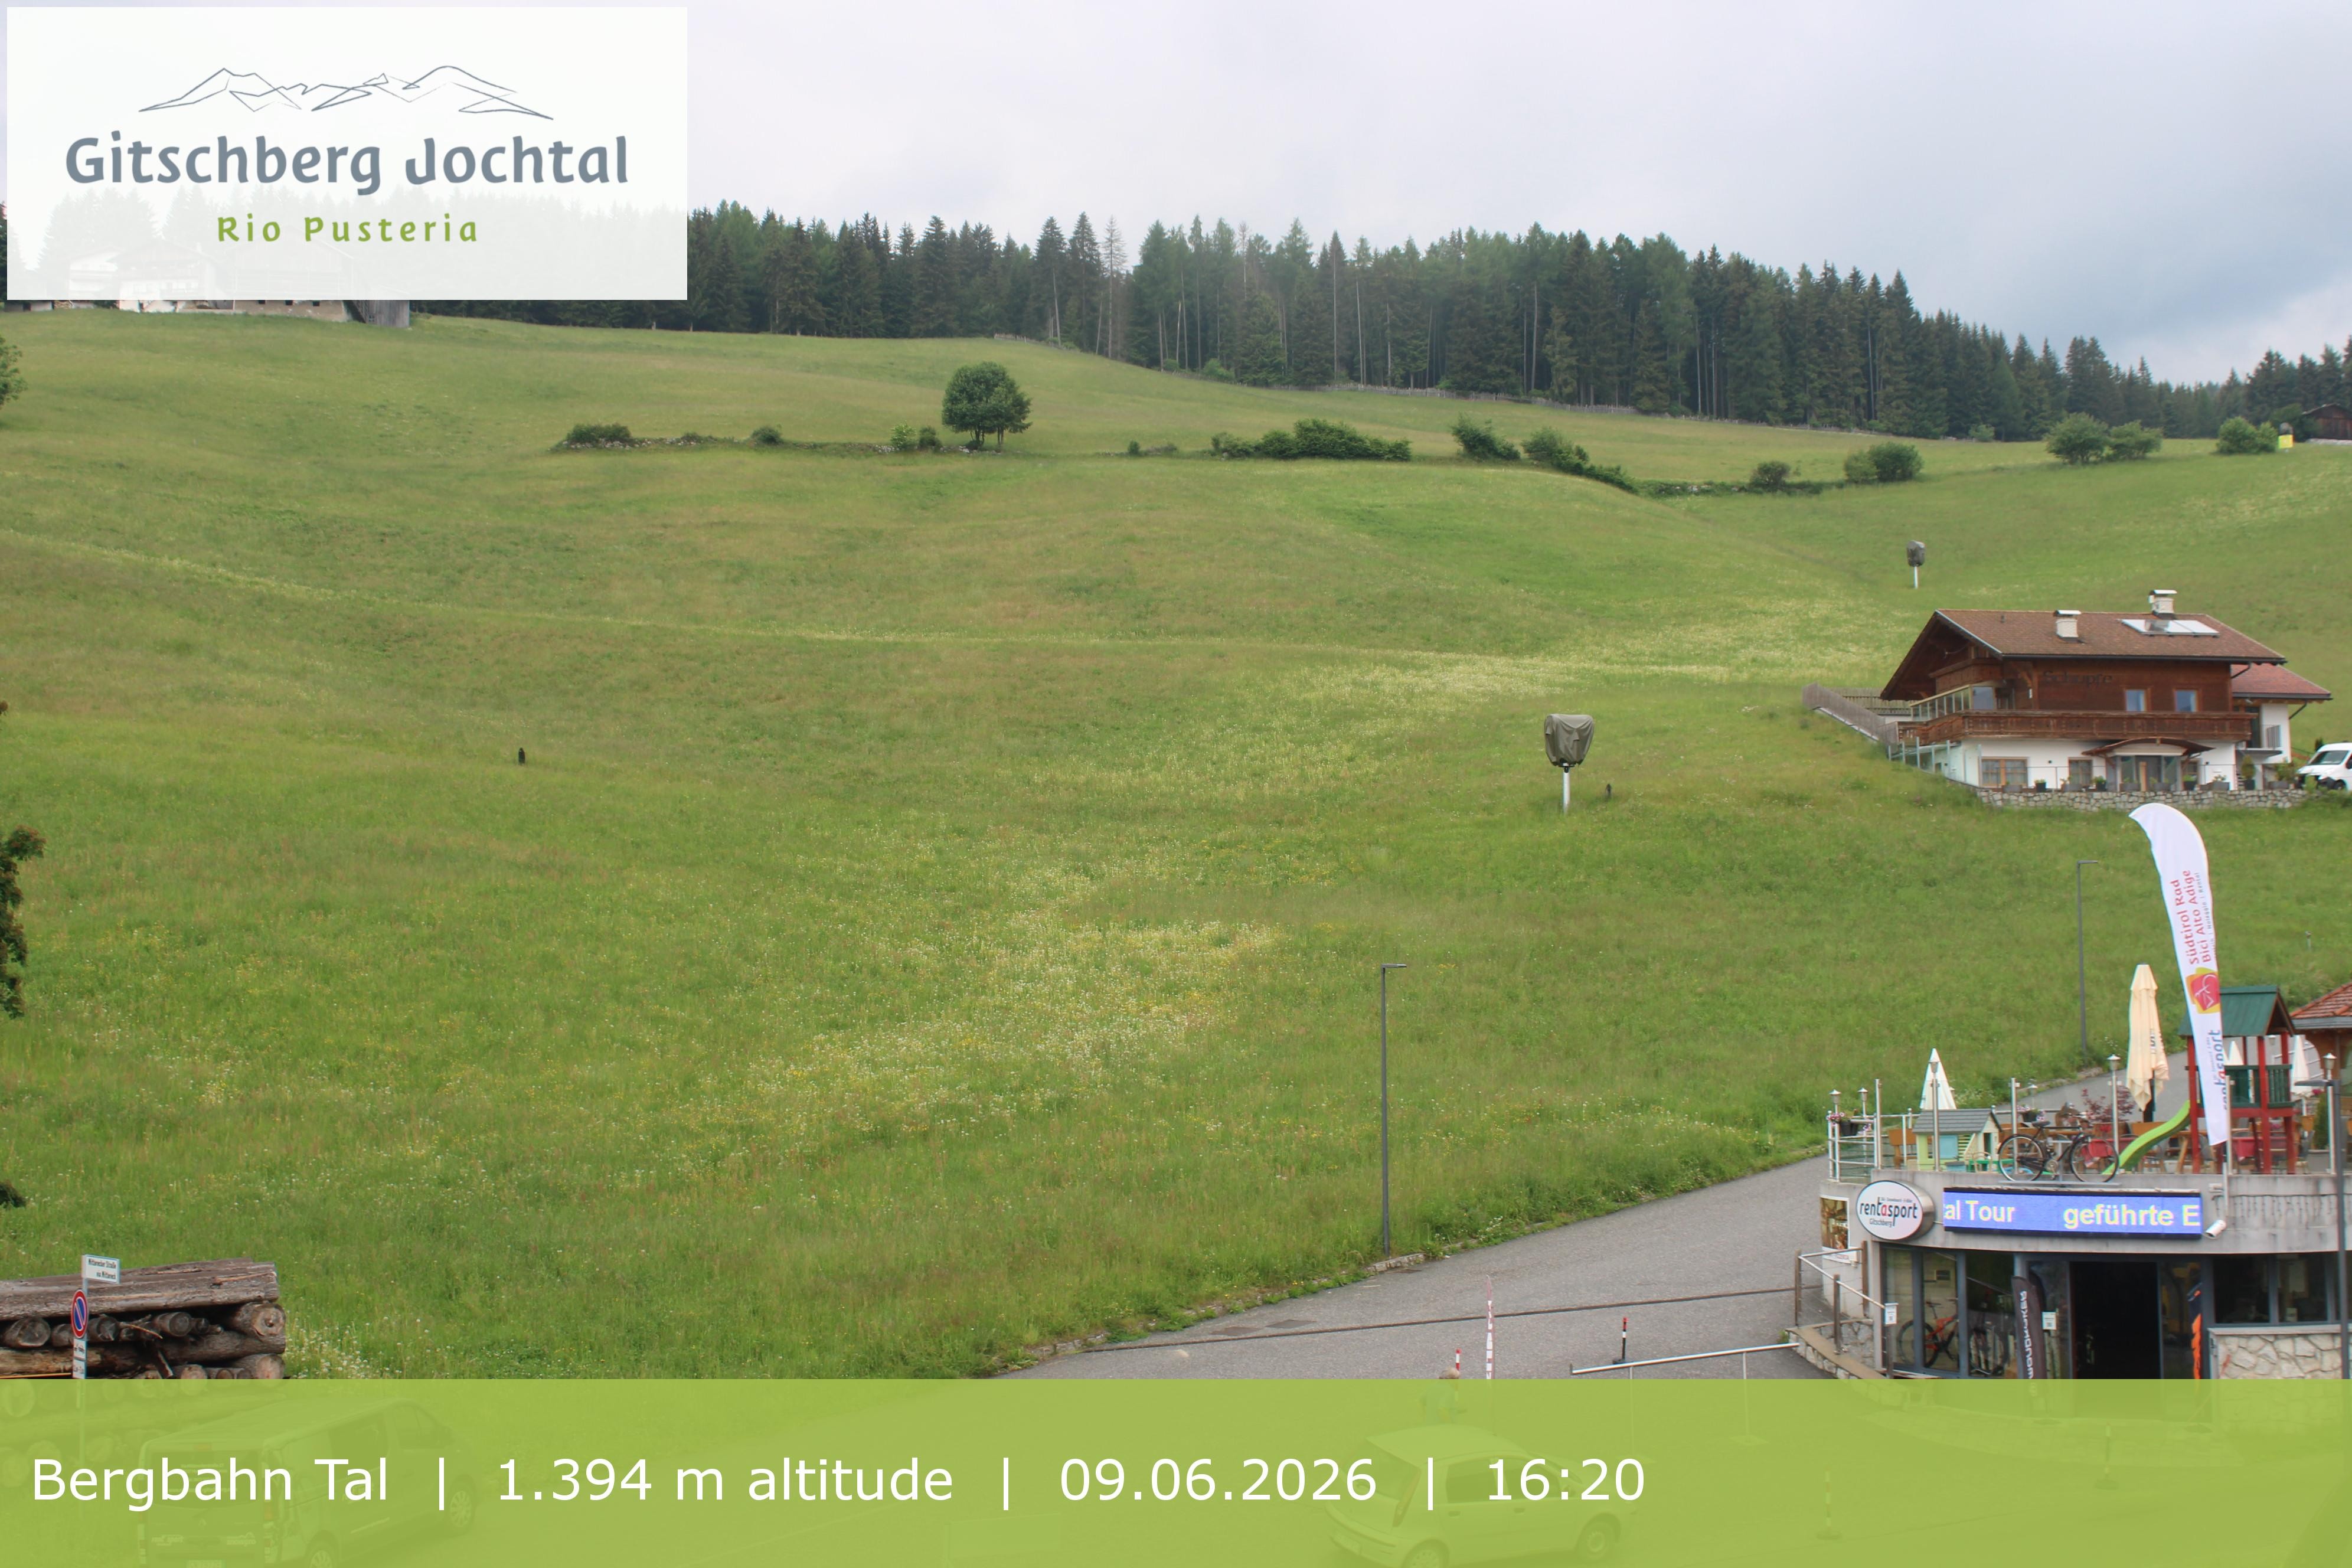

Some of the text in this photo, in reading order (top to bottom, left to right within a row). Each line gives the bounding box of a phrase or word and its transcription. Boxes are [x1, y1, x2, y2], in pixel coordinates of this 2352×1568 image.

[2170, 879, 2199, 965] Südtirol Rad
[2183, 870, 2211, 963] Bici Alto Adige
[1860, 1197, 1917, 1226] rentasport
[1944, 1200, 1960, 1220] al
[1965, 1200, 2015, 1222] Tour
[2063, 1204, 2174, 1229] geführte
